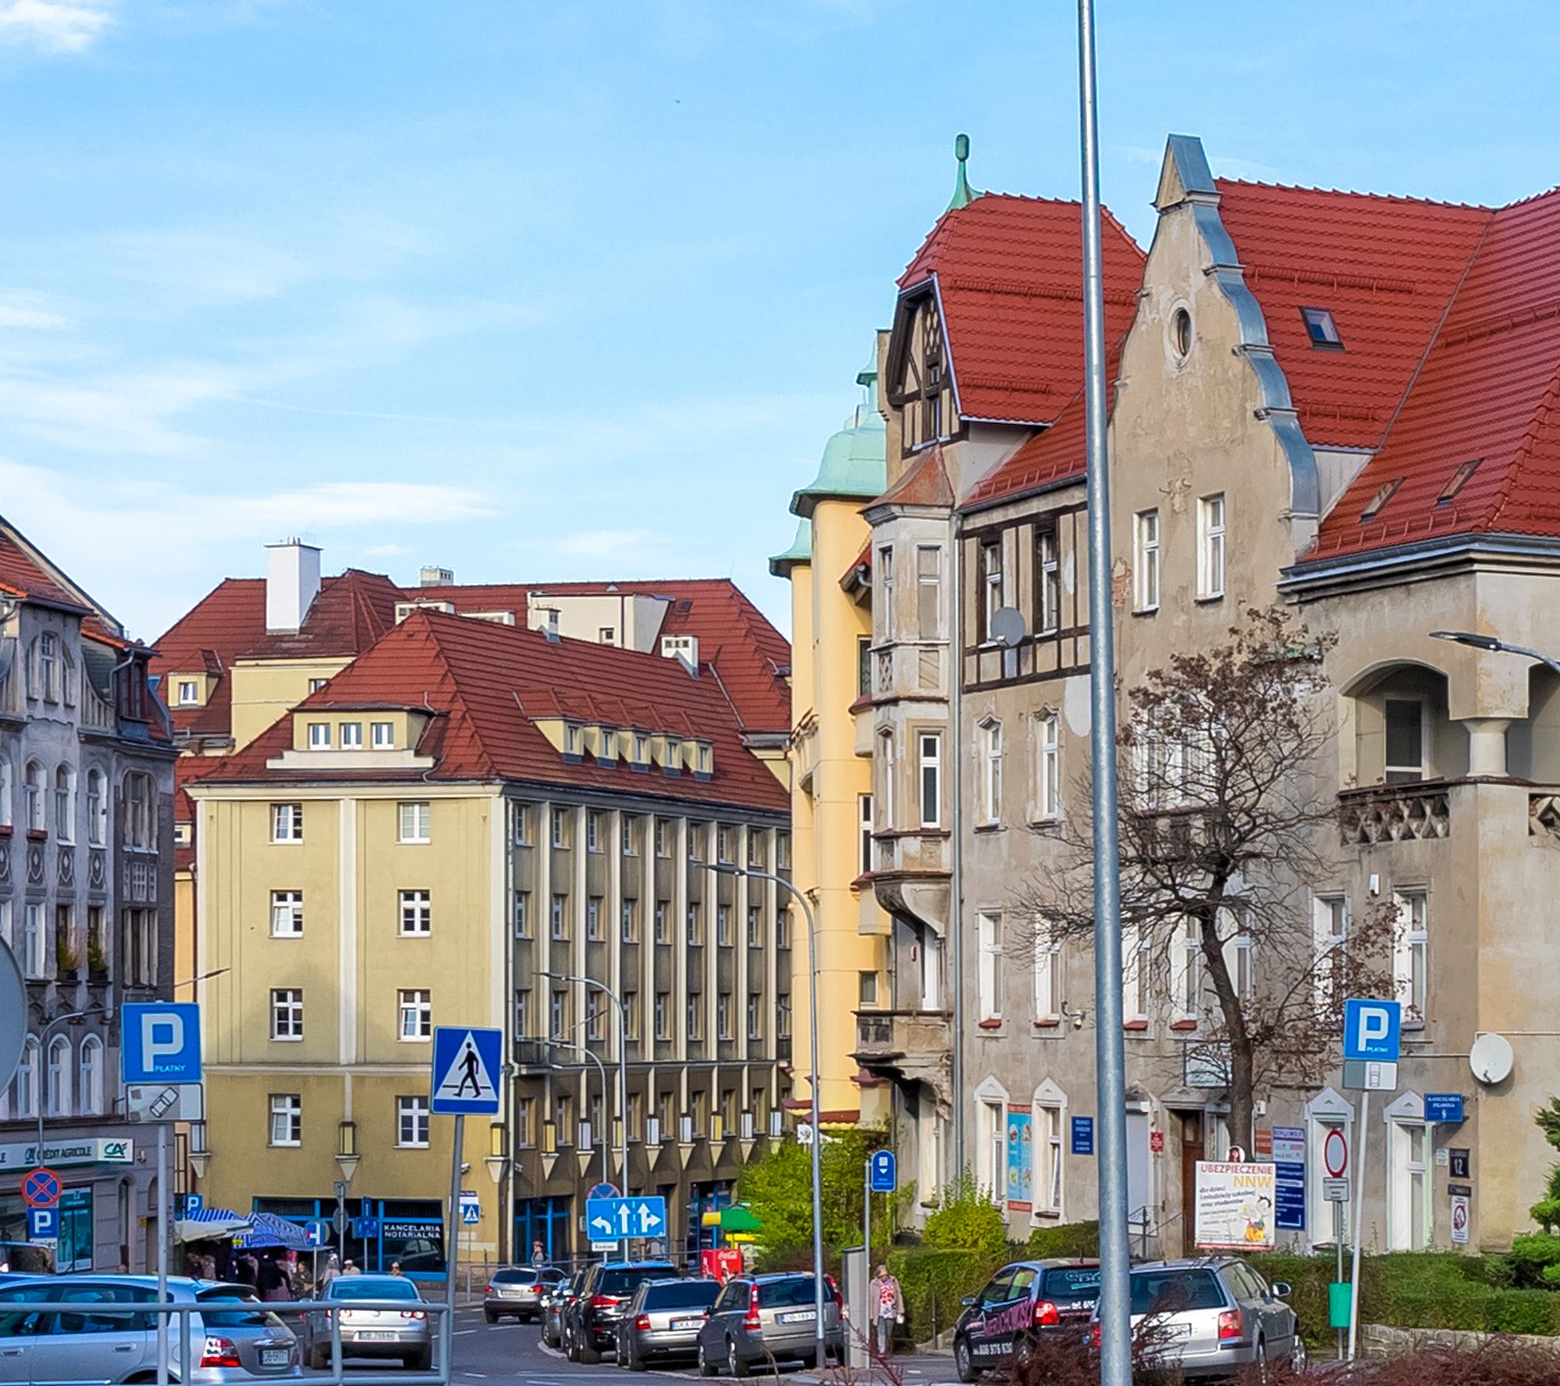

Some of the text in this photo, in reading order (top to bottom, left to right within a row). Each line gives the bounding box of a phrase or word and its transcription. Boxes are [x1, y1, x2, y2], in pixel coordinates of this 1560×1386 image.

[1358, 1007, 1389, 1051] P
[142, 1013, 184, 1072] P
[61, 1146, 92, 1158] AGRICOLE
[1201, 1164, 1273, 1174] UBEZPIECZENIE
[1233, 1176, 1271, 1187] NNW
[188, 1196, 198, 1211] P
[35, 1211, 51, 1233] P
[384, 1224, 440, 1232] KANCELARIA
